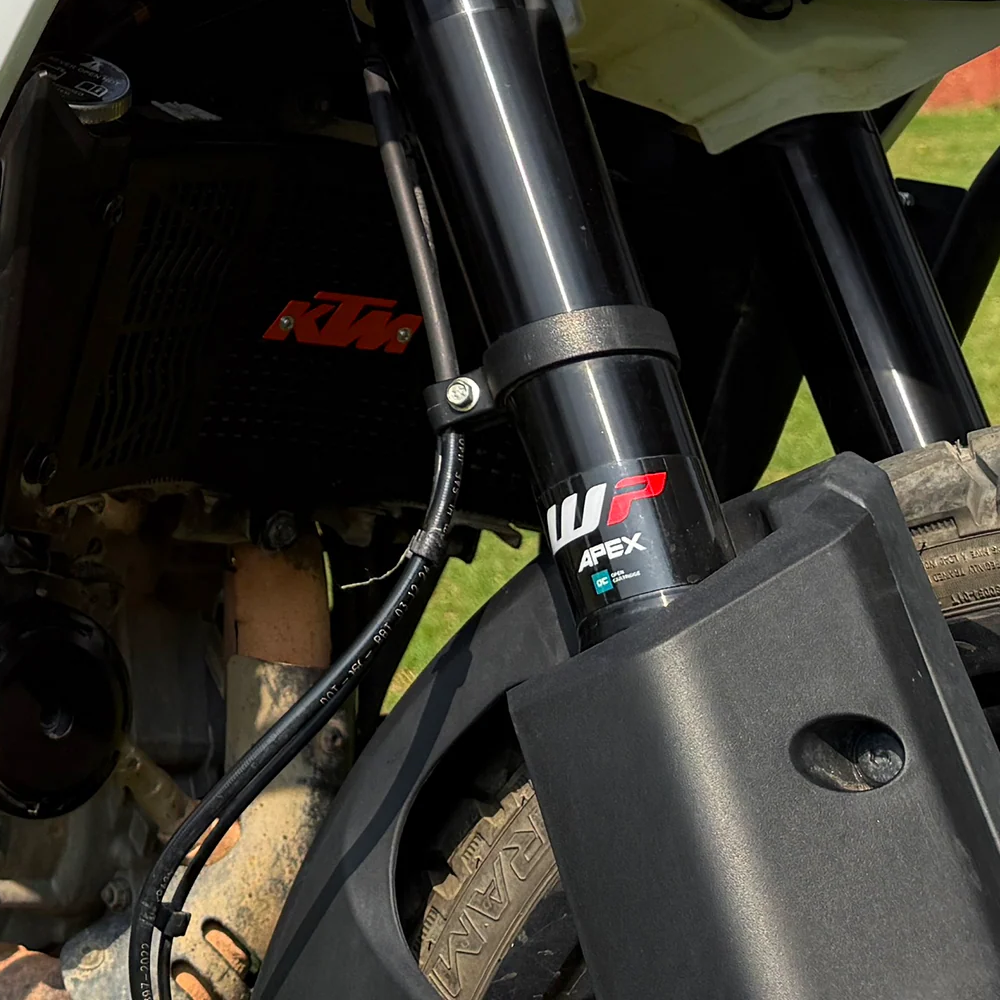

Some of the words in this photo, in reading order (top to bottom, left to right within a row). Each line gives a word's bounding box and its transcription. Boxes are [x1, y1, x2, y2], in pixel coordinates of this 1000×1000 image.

[262, 291, 424, 354] KTM
[546, 471, 667, 556] WP
[578, 532, 647, 574] APEX
[596, 576, 609, 588] OC
